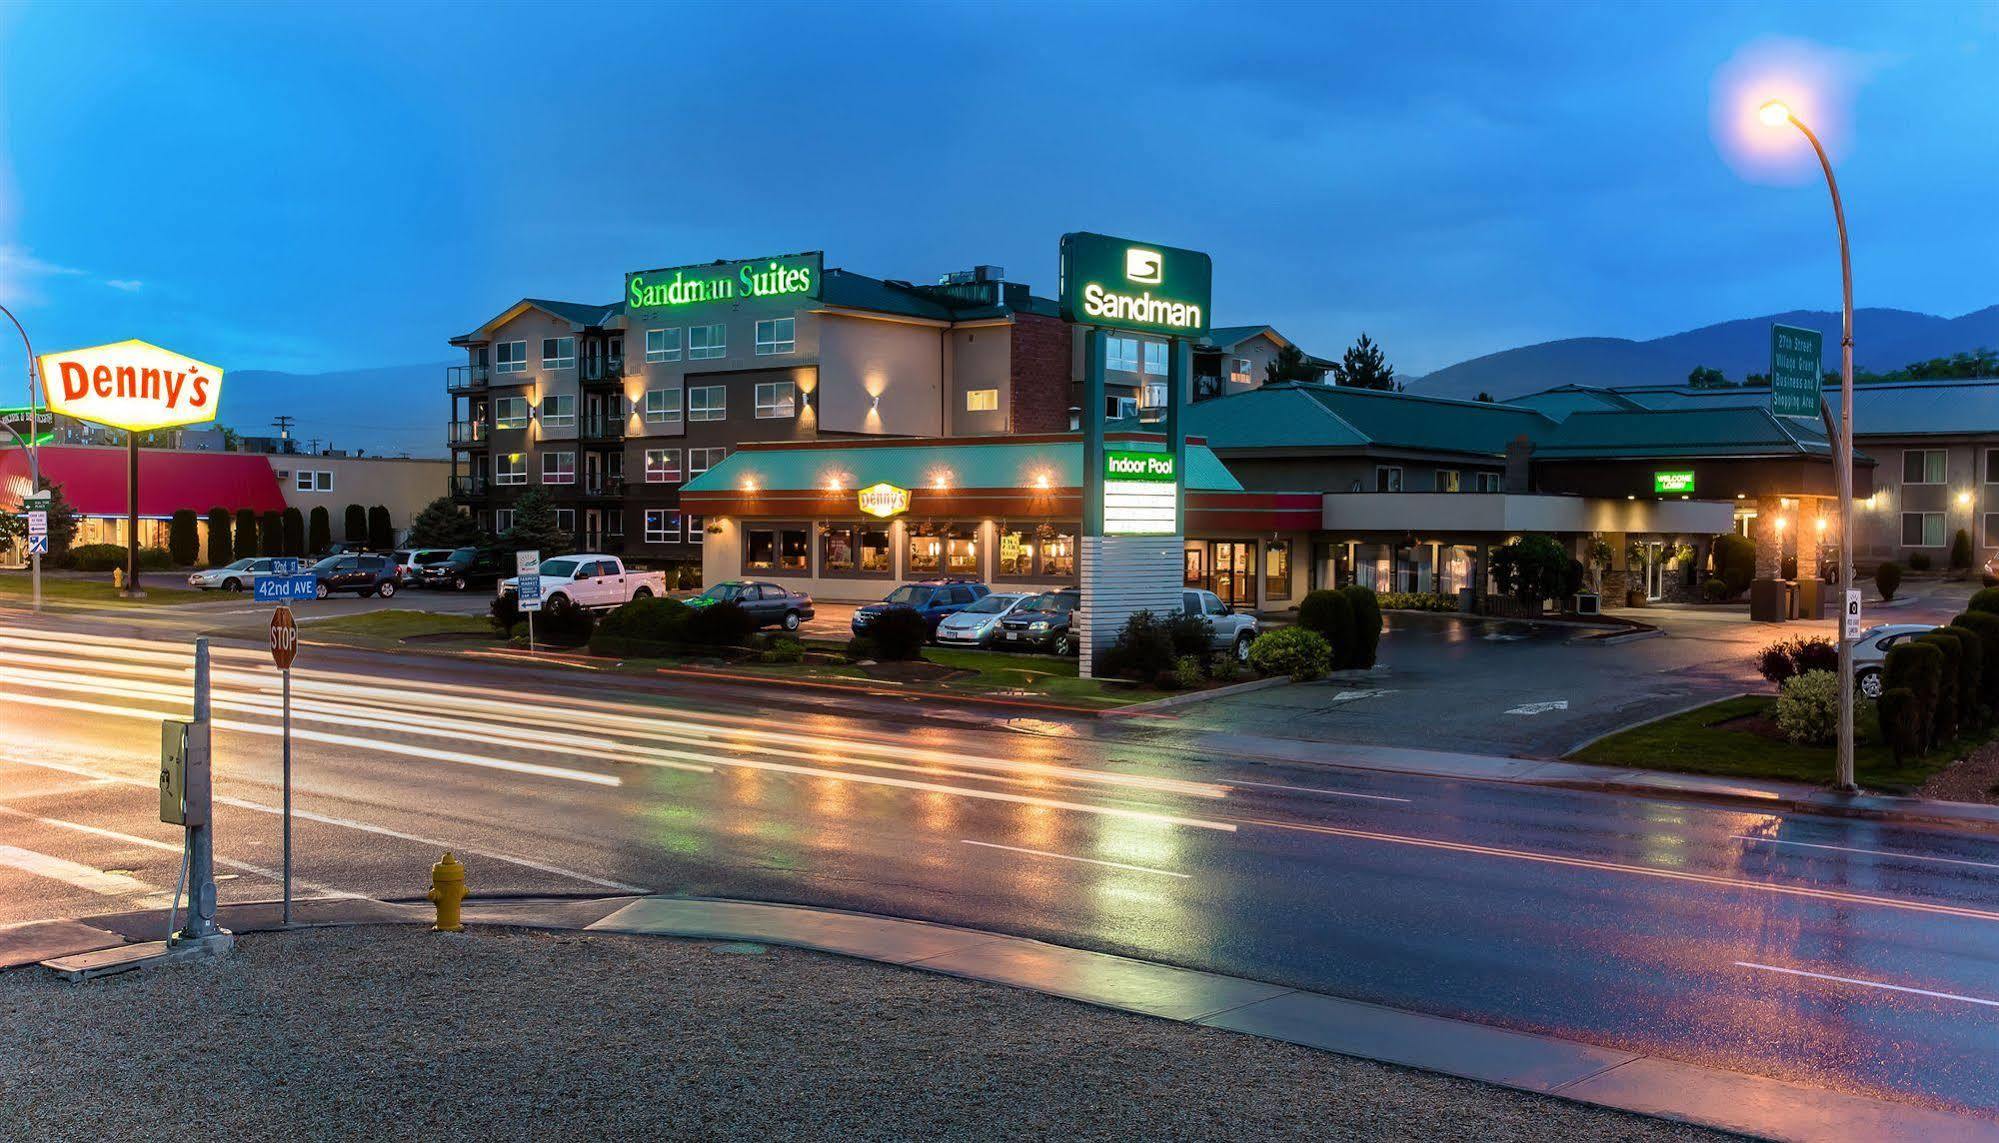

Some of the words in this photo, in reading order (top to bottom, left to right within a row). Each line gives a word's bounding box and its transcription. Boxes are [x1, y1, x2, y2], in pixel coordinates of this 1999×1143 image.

[630, 272, 733, 309] Sandman
[739, 262, 810, 297] Suites
[1084, 283, 1201, 328] Sandman
[1778, 334, 1793, 349] 27th
[1794, 337, 1813, 353] Street
[1775, 353, 1796, 373] Village
[1798, 356, 1814, 371] Green
[58, 361, 210, 409] Denny's
[1775, 371, 1803, 390] Business
[1773, 391, 1800, 412] Shopping
[1802, 394, 1814, 409] Area
[1108, 456, 1146, 474] Indoor
[1148, 457, 1173, 475] Pool
[862, 490, 906, 509] Denny's
[273, 560, 287, 573] 32nd
[259, 581, 289, 596] 42nd
[294, 581, 313, 594] AVE
[271, 626, 296, 651] STOP
